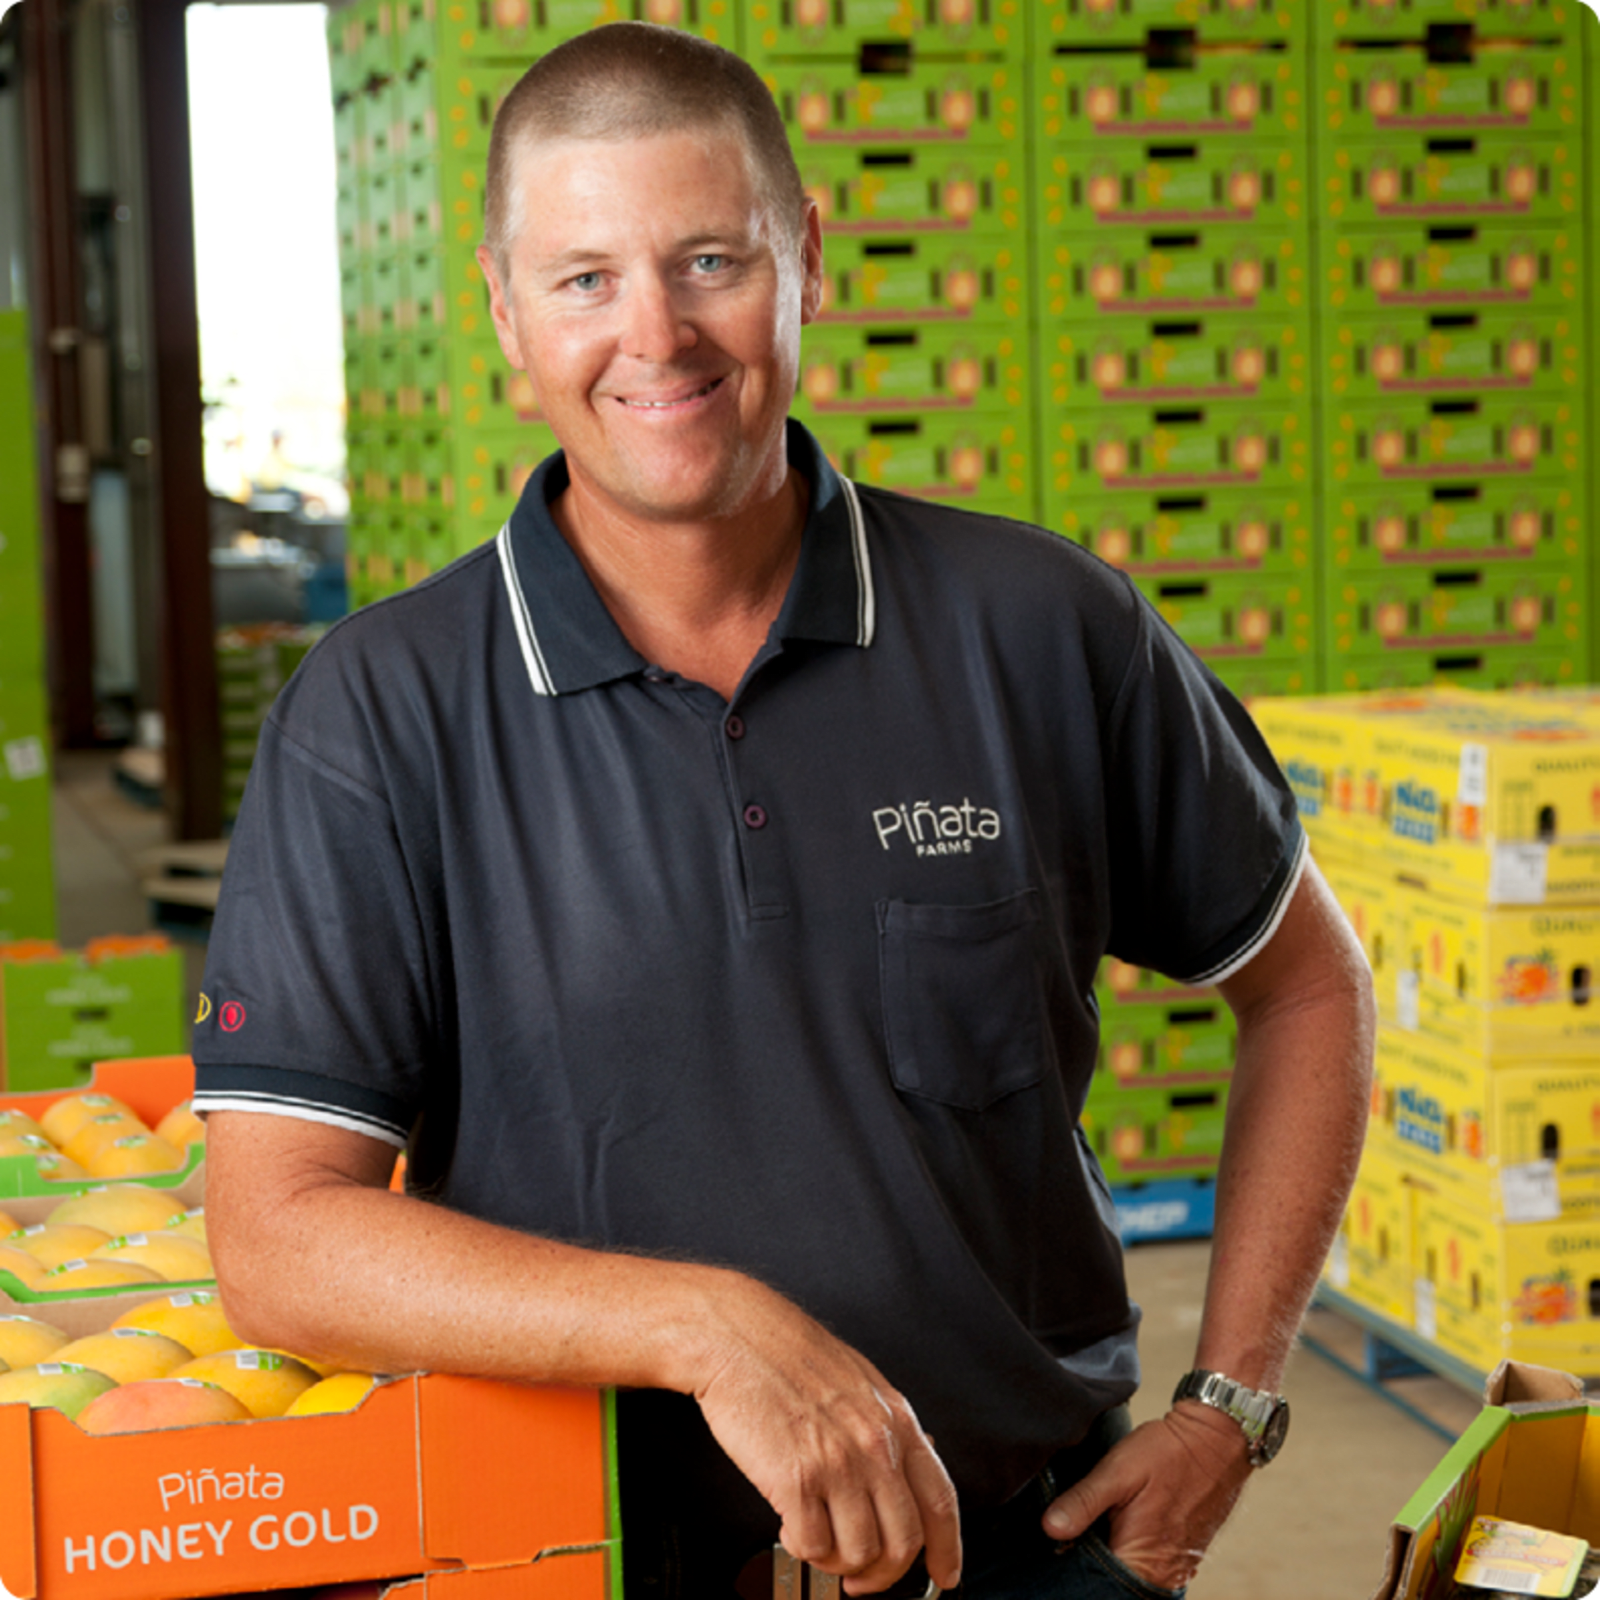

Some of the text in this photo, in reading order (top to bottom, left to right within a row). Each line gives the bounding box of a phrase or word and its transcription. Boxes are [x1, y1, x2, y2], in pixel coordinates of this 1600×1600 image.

[872, 797, 1000, 850] Piñata
[915, 839, 972, 858] FARMS
[158, 1464, 285, 1511] Piñata
[64, 1504, 379, 1573] HONEY GOLD
